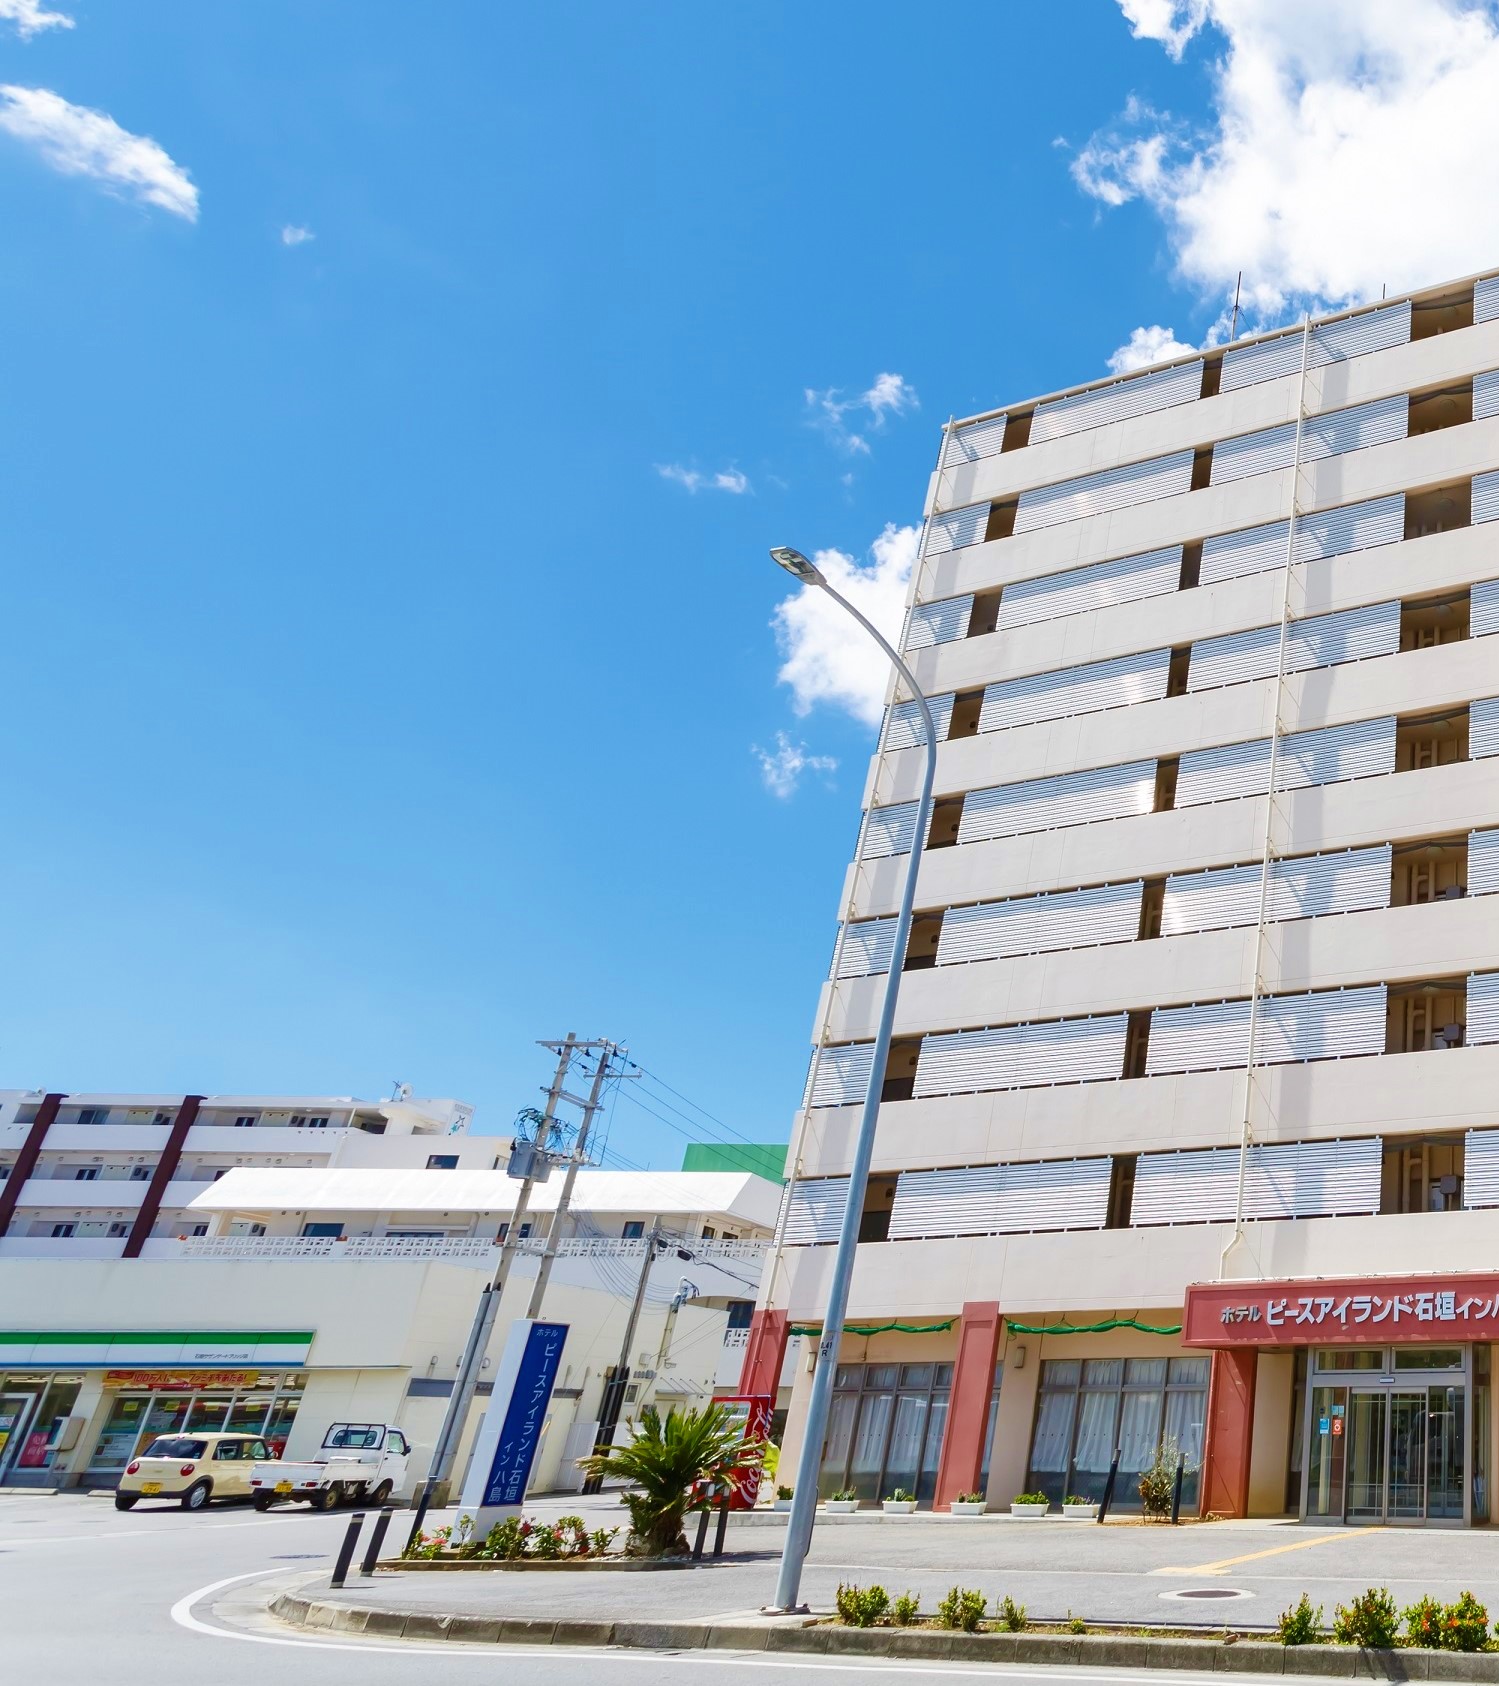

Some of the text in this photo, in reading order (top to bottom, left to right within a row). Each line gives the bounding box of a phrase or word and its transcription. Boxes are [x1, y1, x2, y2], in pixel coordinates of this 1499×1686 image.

[1220, 1305, 1261, 1324] ホテル
[536, 1328, 559, 1338] ホテル
[487, 1441, 514, 1503] イン八島
